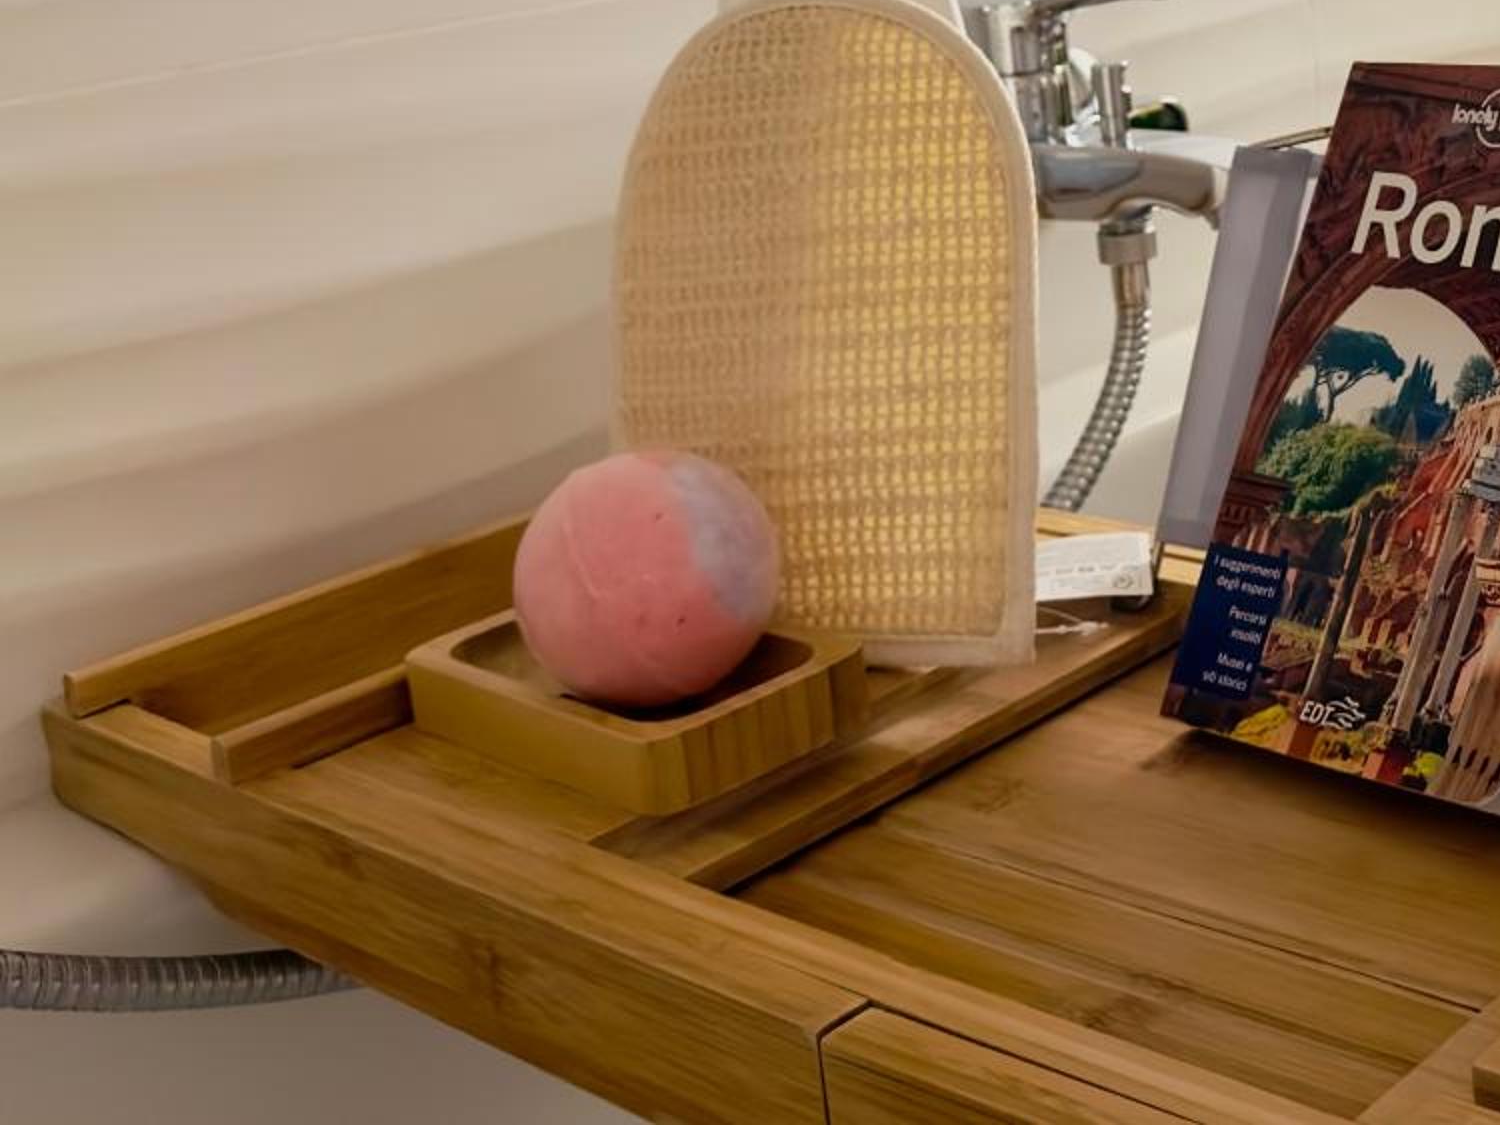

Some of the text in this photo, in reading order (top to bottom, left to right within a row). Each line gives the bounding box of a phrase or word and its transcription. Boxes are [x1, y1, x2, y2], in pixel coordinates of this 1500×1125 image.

[1451, 103, 1499, 132] lonely
[1215, 575, 1241, 591] degli
[1300, 699, 1335, 724] EDT
